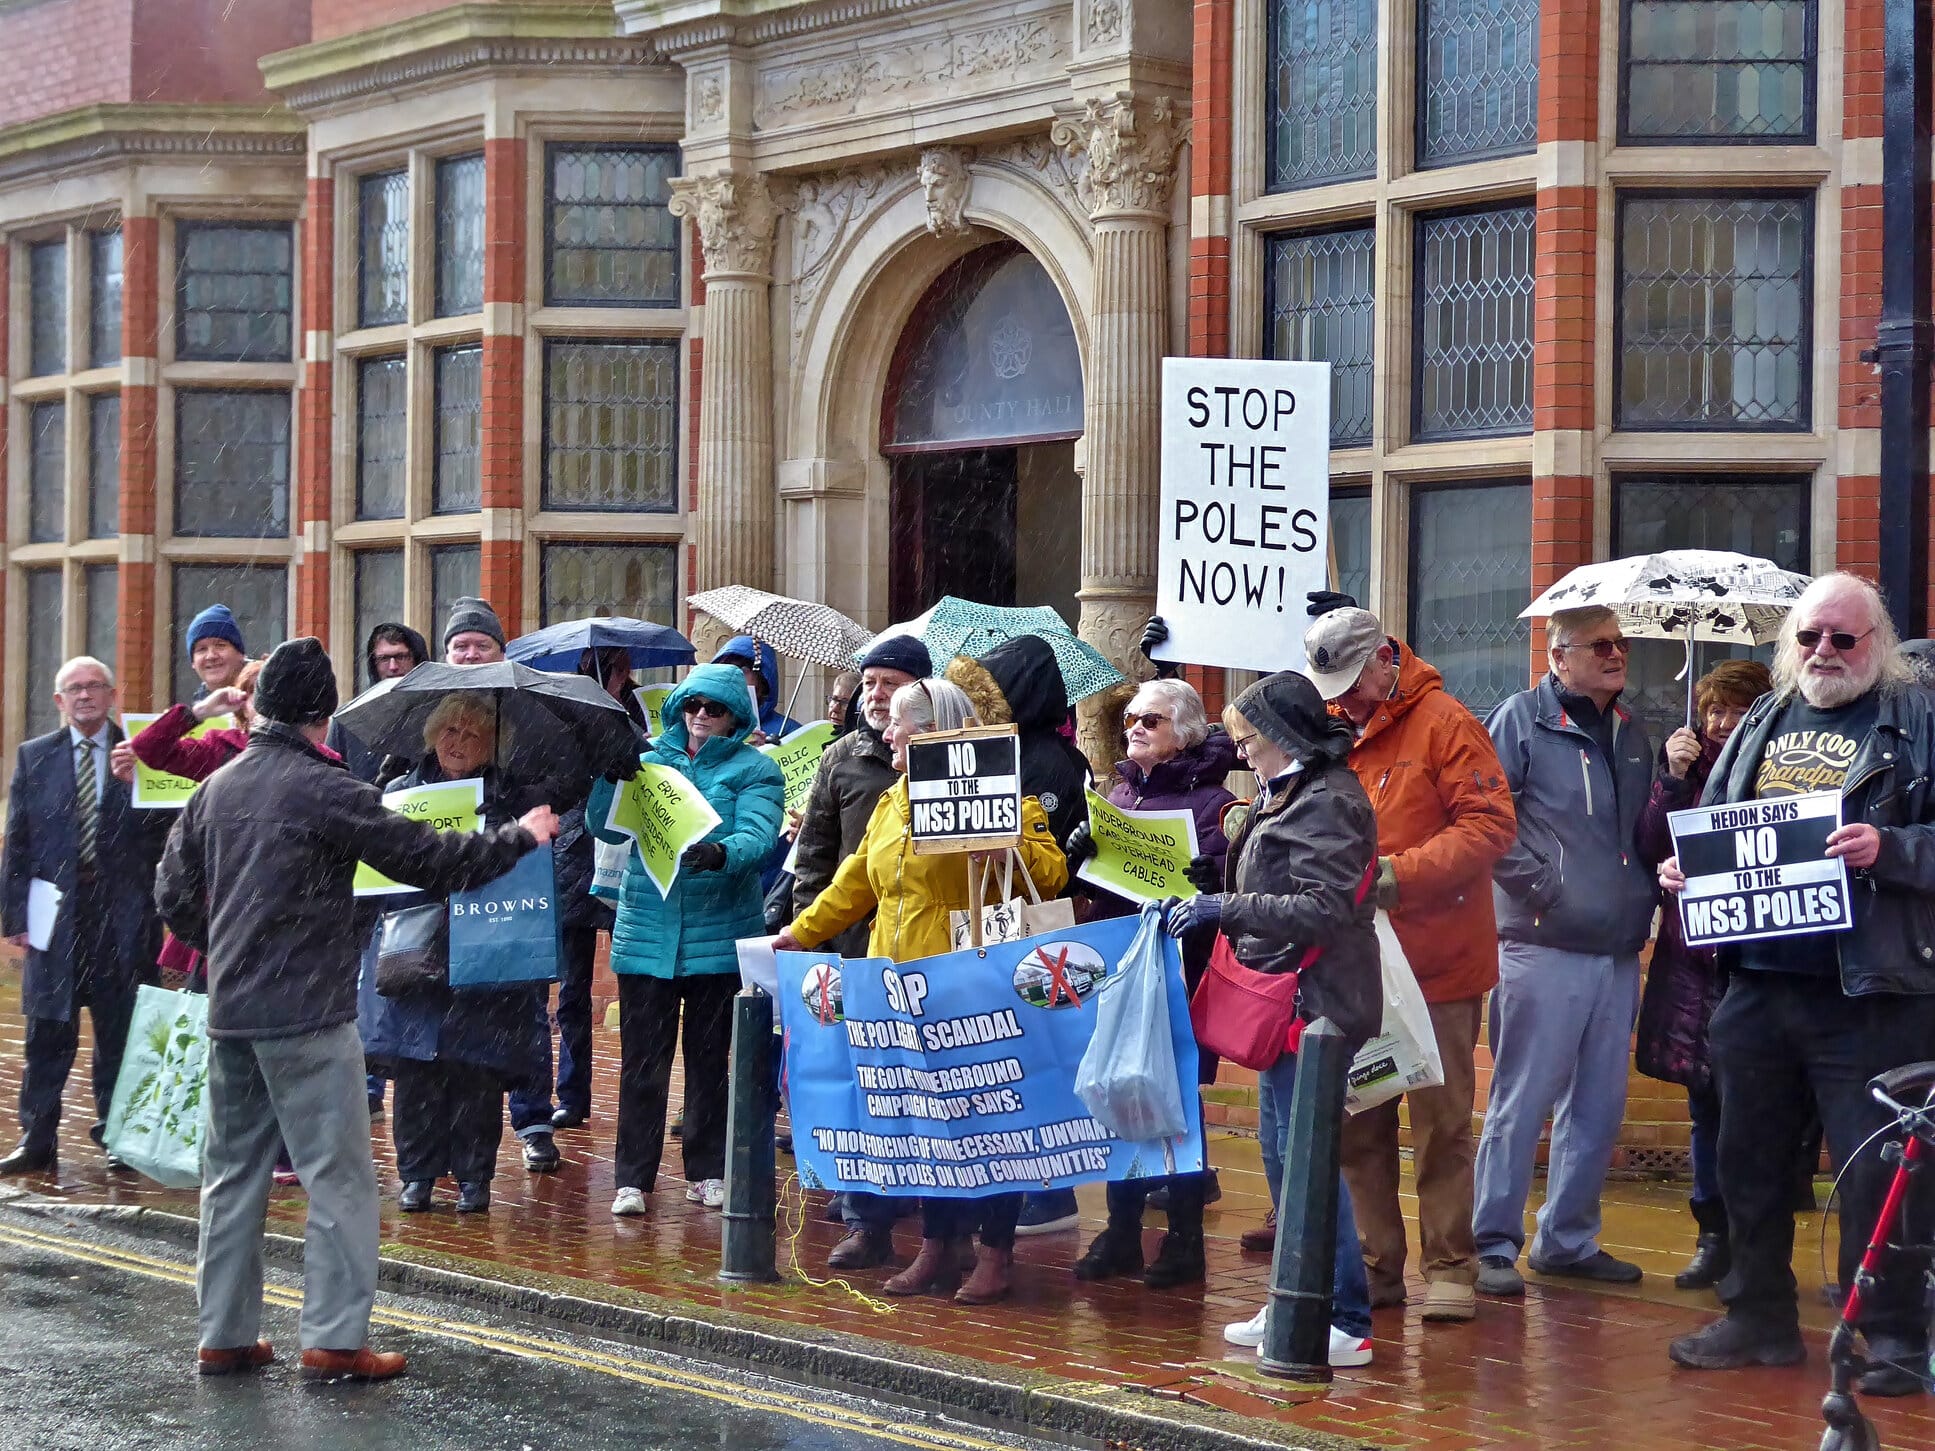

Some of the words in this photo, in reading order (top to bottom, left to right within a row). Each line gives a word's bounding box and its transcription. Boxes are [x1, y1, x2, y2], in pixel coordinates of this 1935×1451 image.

[952, 400, 1019, 424] OUNTY
[1026, 395, 1073, 417] HALL
[1187, 386, 1296, 431] STOP
[1200, 442, 1287, 491] THE
[1175, 499, 1318, 552] POLES
[1178, 558, 1285, 613] NOW!
[778, 746, 809, 768] BLIC
[947, 742, 977, 777] NO
[1764, 730, 1817, 758] ONLY
[1815, 731, 1857, 761] COO
[657, 780, 682, 805] ERYC
[947, 780, 960, 796] TO
[962, 779, 980, 795] THE
[652, 799, 676, 830] NOW!
[913, 800, 957, 833] MS3
[959, 797, 1016, 831] POLES
[1710, 806, 1758, 830] HEDON
[1762, 802, 1799, 821] SAYS
[1111, 842, 1175, 873] OVERHEAD
[1734, 826, 1777, 868] NO
[1123, 861, 1166, 888] CABLES
[1734, 872, 1754, 890] TO
[1755, 868, 1782, 887] THE
[454, 897, 549, 916] BROWNS
[1687, 896, 1748, 937] MS3
[1753, 885, 1841, 929] POLES
[845, 1019, 868, 1047] THE
[922, 1009, 1023, 1051] SCANDAL
[857, 1065, 879, 1089] THE
[867, 1093, 928, 1118] CAMPAIGN
[973, 1088, 1023, 1115] SAYS:
[865, 1134, 920, 1159] FORCING
[918, 1136, 931, 1160] OF
[931, 1128, 1041, 1161] UNNECESSARY,
[1038, 1117, 1117, 1149] UNWAN
[896, 1162, 937, 1187] POLES
[934, 1164, 956, 1187] ON
[954, 1163, 990, 1188] OUR
